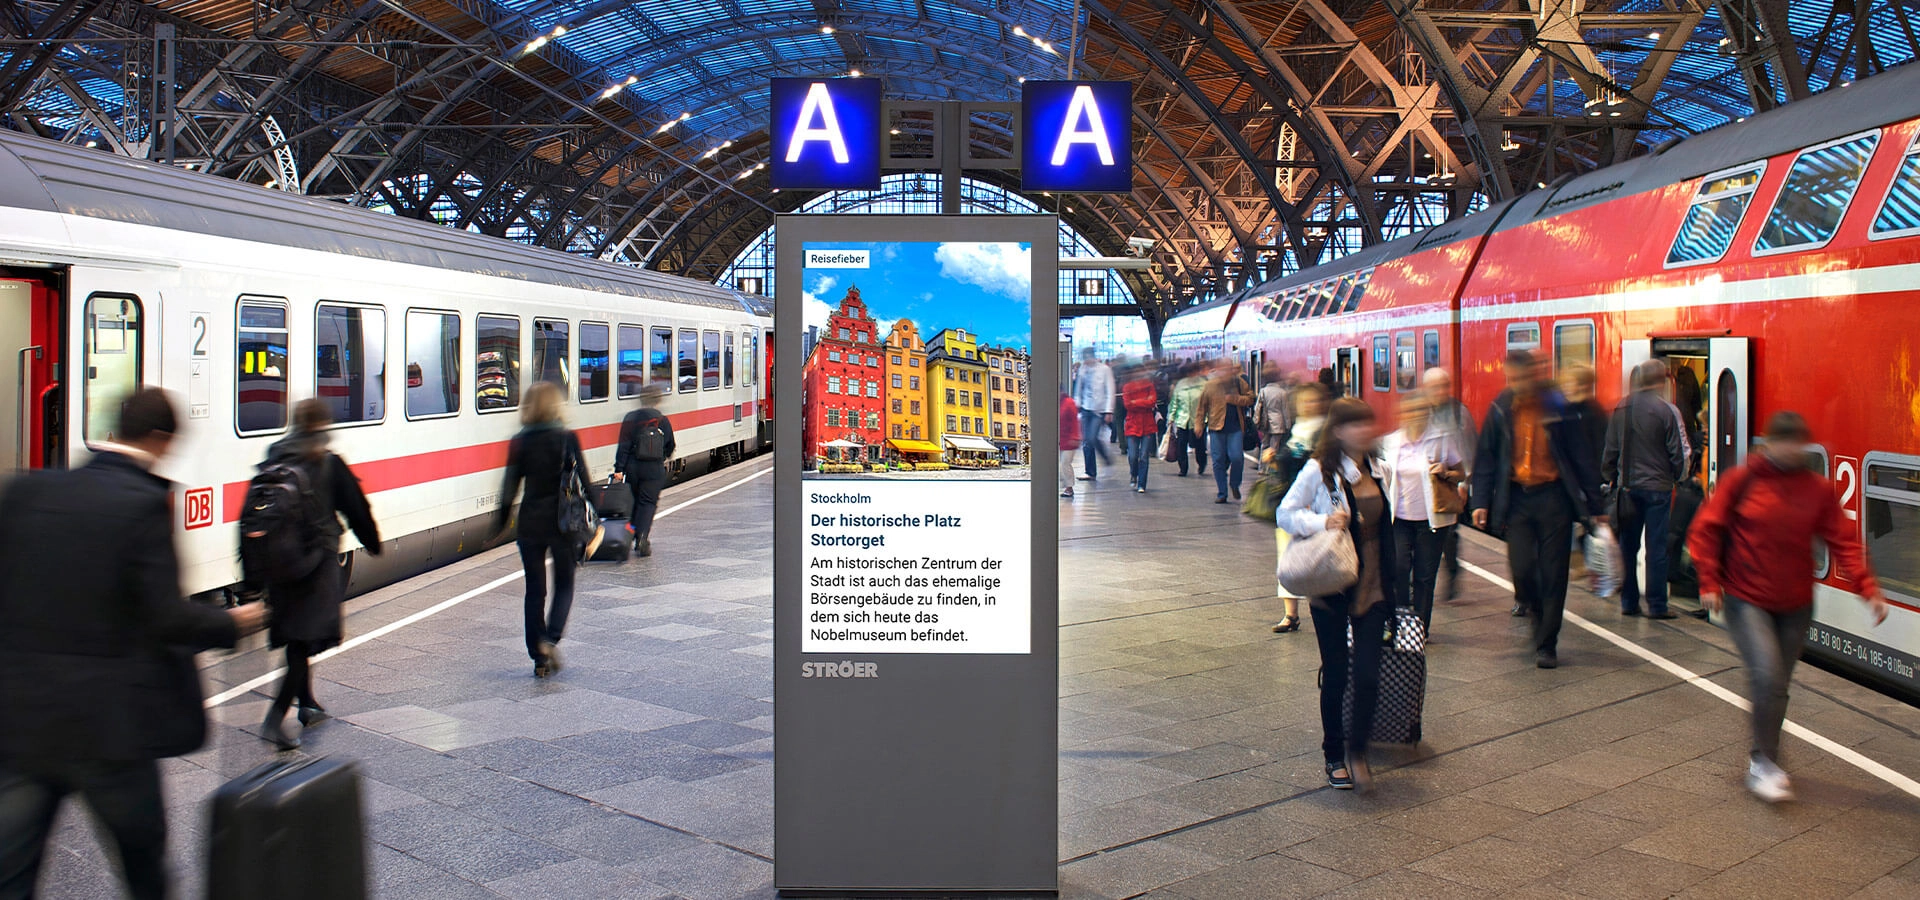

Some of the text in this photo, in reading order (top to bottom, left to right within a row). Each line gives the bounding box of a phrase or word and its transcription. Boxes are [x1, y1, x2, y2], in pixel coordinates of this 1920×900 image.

[785, 82, 850, 164] A
[1050, 85, 1116, 166] A
[811, 253, 865, 264] Reisefieber
[193, 315, 207, 356] 2
[810, 493, 872, 504] Stockholm
[1836, 461, 1857, 521] 2
[188, 494, 210, 523] DB
[811, 513, 962, 527] Der historische Platz
[810, 533, 885, 549] Stortorget
[810, 557, 1003, 570] Am historischen Zentrum der
[810, 575, 1001, 588] Stadt ist auch das ehemalige
[810, 593, 996, 607] Börsengebäude zu finden, in
[810, 611, 939, 623] dem sich heute das
[810, 629, 969, 642] Nobelmuseum befindet.
[1820, 630, 1830, 647] 50
[1831, 635, 1841, 651] 80
[1843, 639, 1868, 661] 25-04
[1869, 649, 1893, 671] 185-8
[801, 660, 879, 678] STRÖER
